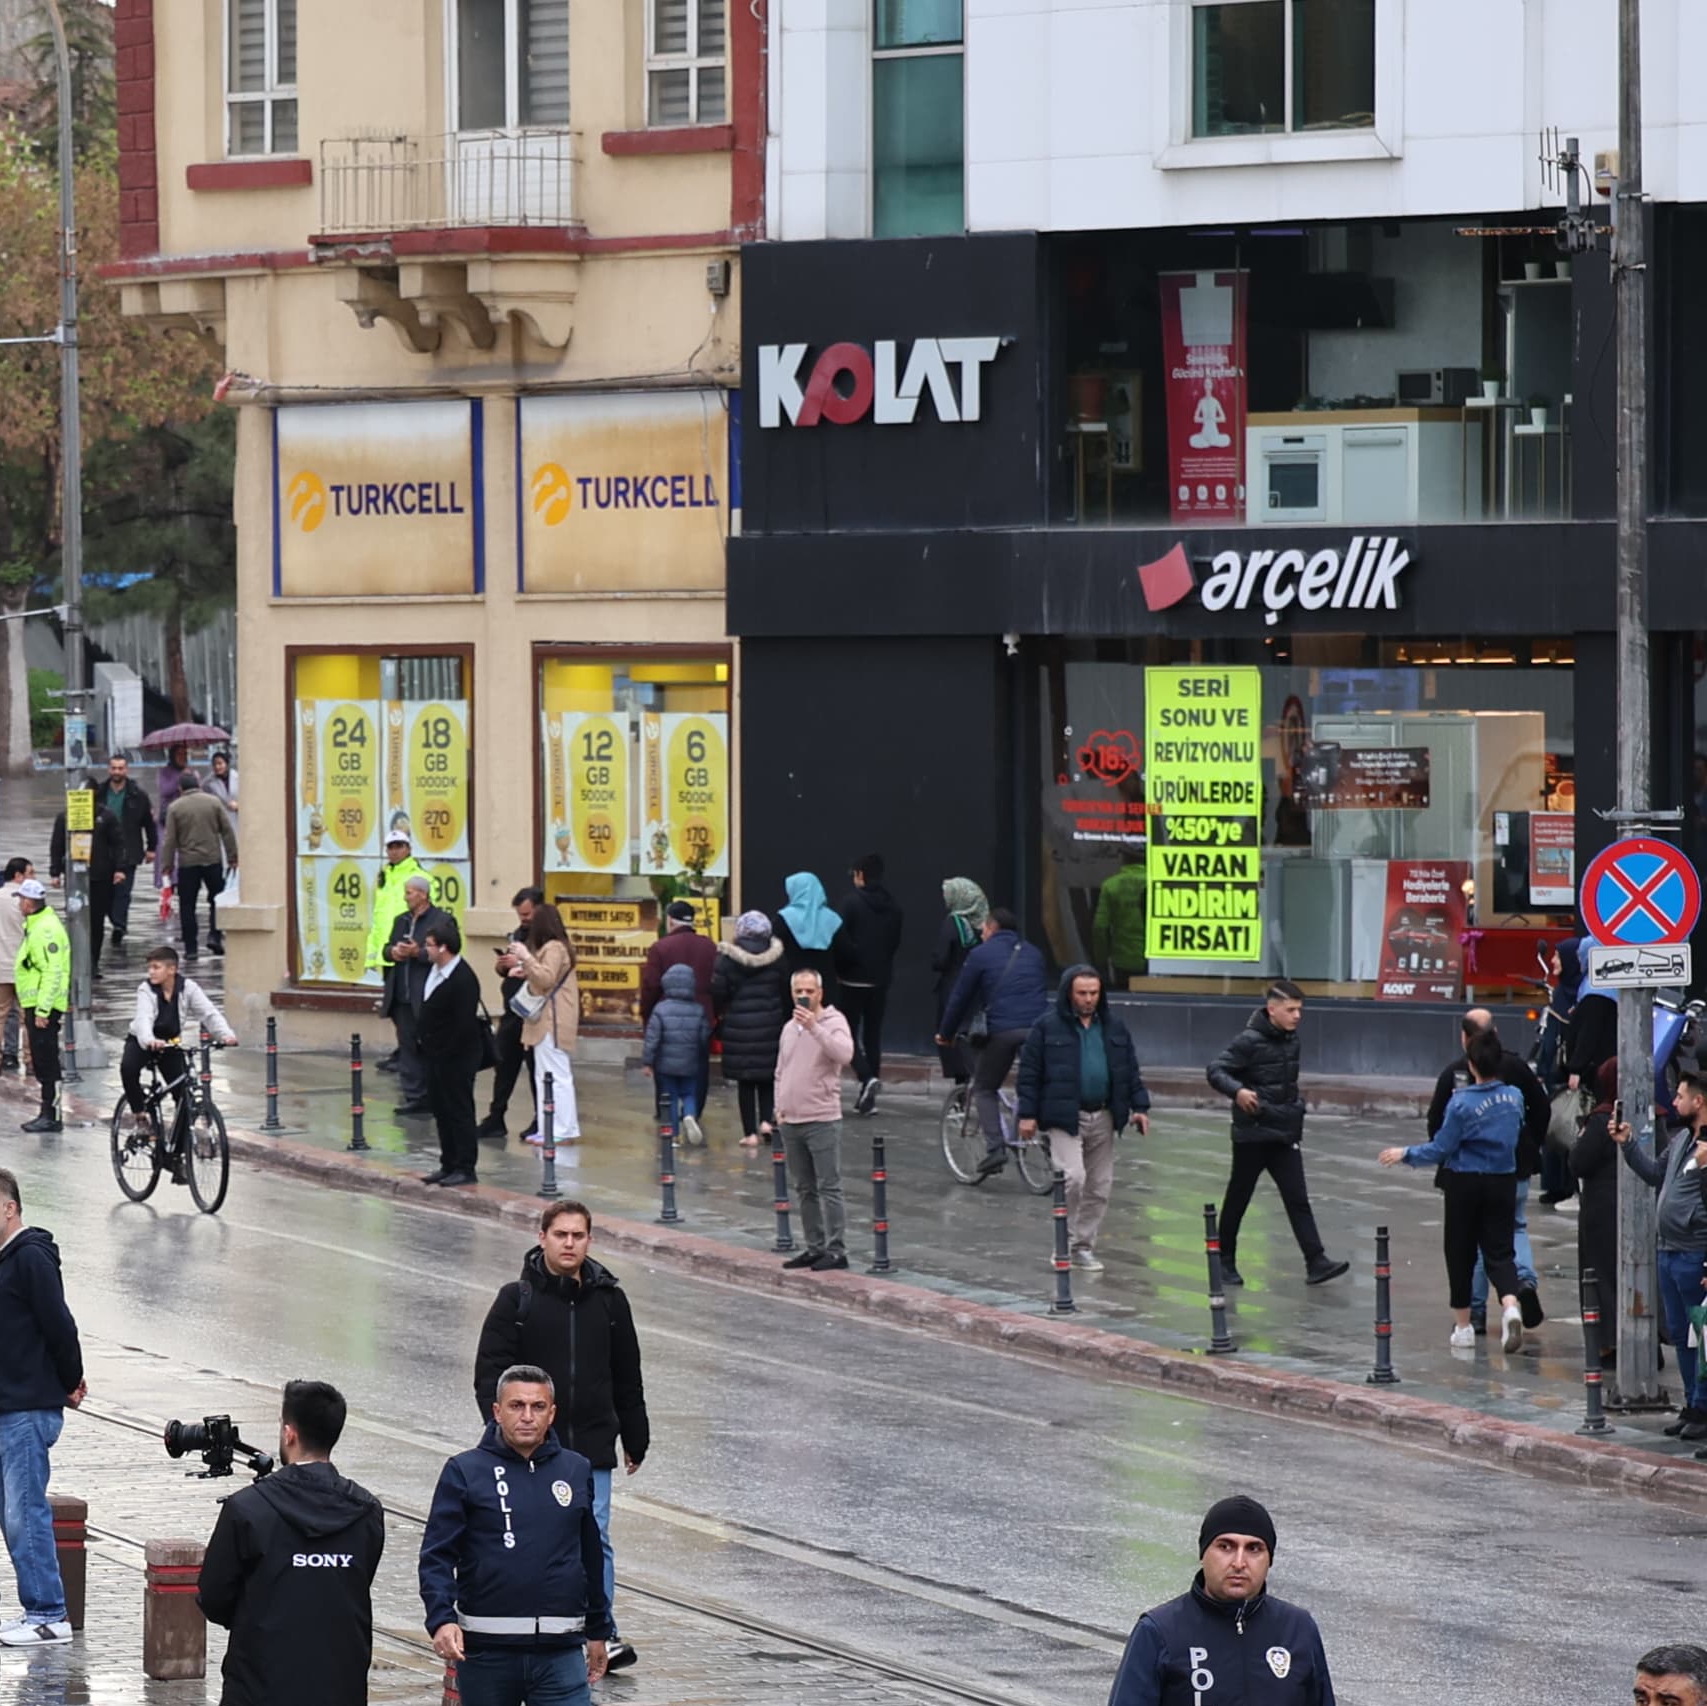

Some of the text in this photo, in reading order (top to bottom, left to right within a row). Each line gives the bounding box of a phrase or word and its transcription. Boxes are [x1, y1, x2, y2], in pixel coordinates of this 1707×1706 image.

[758, 336, 1001, 428] KOLAT
[330, 481, 464, 516] TURKCELL
[576, 473, 720, 509] TURKCELL
[1201, 536, 1410, 626] arçelik
[1178, 674, 1230, 697] SERİ
[1160, 709, 1249, 727] SONU VE
[332, 717, 367, 748] 24
[421, 717, 452, 749] 18
[582, 730, 613, 762] 12
[686, 730, 705, 762] 6
[1154, 736, 1254, 763] REVİZYONLU
[338, 752, 362, 771] GB
[424, 754, 448, 772] GB
[585, 766, 610, 785] GB
[684, 767, 709, 787] GB
[1153, 775, 1254, 803] ÜRÜNLERDE
[338, 809, 363, 824] 350
[424, 809, 450, 825] 270
[346, 824, 358, 837] TL
[430, 825, 444, 839] TL
[588, 824, 611, 840] 210
[685, 827, 708, 842] 170
[592, 840, 606, 854] TL
[1163, 853, 1248, 878] VARAN
[333, 873, 361, 899] 48
[339, 902, 356, 919] GB
[1153, 882, 1256, 919] İNDİRİM
[1159, 925, 1251, 952] FIRSATI
[338, 946, 359, 961] 390
[292, 1553, 354, 1568] SONY
